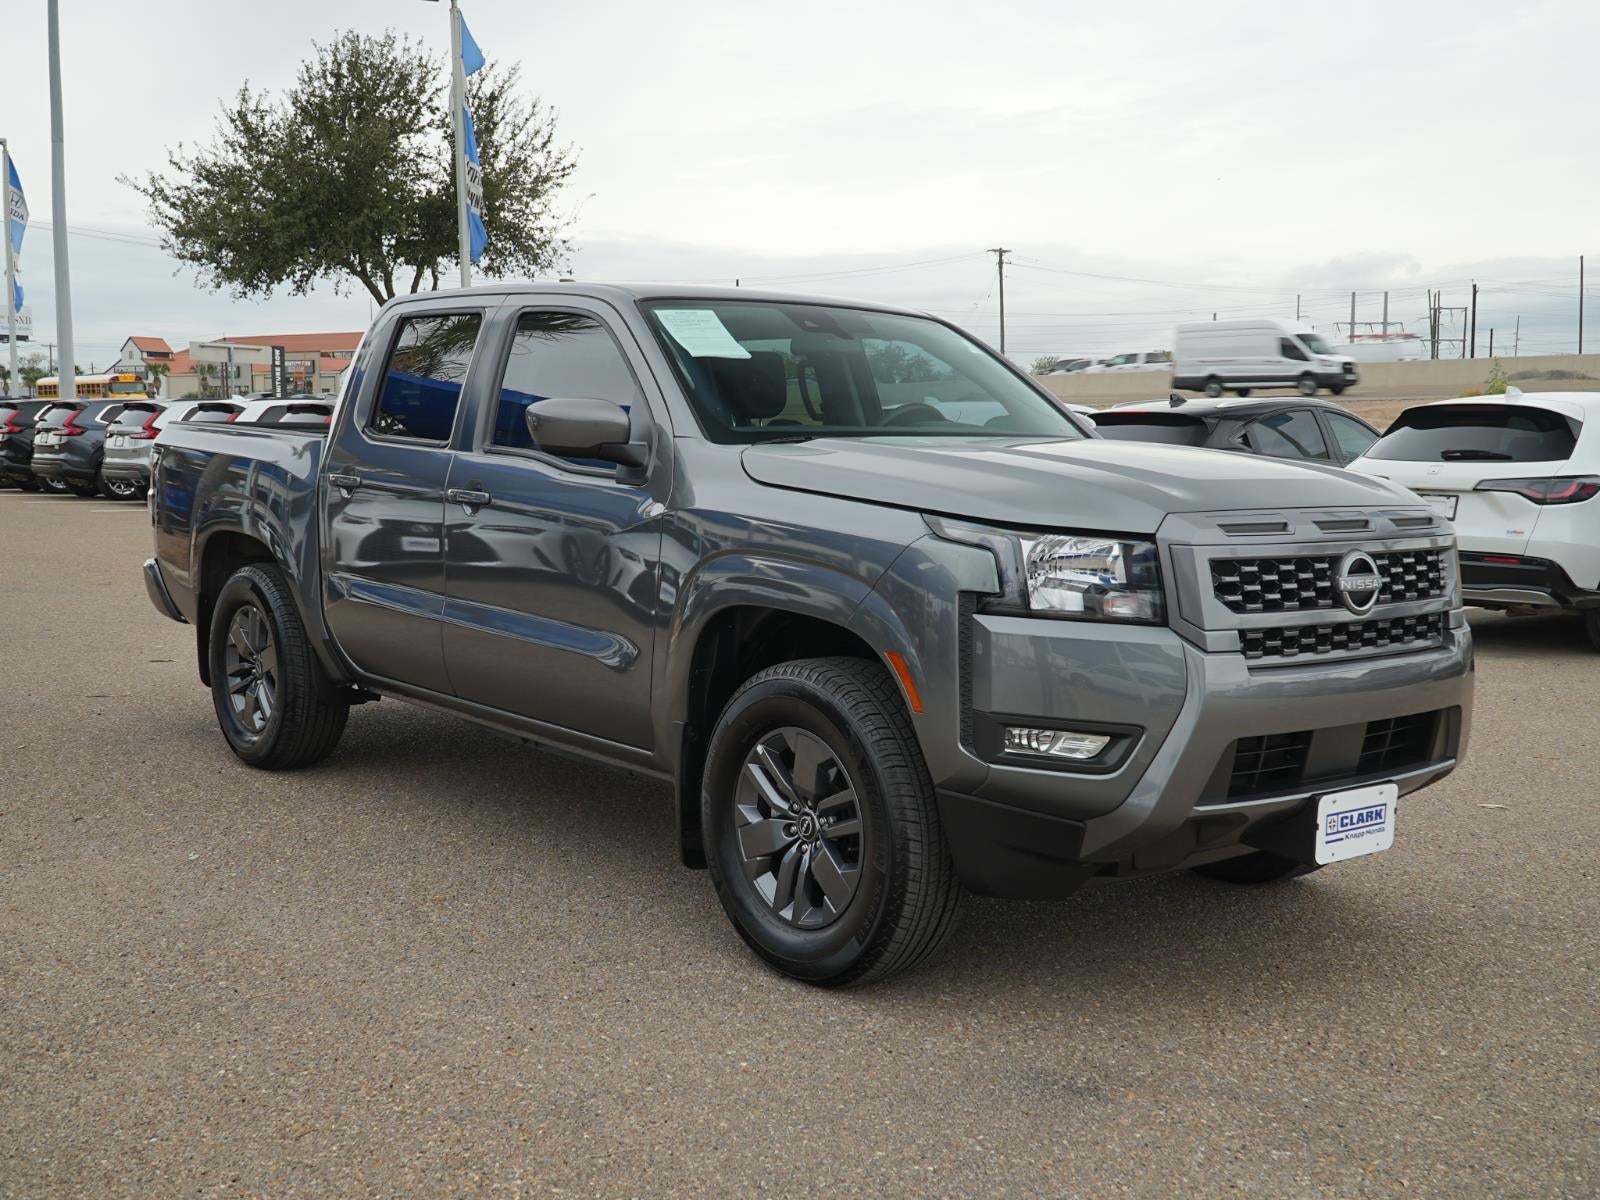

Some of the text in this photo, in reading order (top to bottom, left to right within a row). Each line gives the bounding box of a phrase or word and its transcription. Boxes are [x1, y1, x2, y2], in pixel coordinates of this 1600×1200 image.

[1340, 808, 1383, 828] CLARK
[1344, 826, 1385, 841] Knapp Honda
